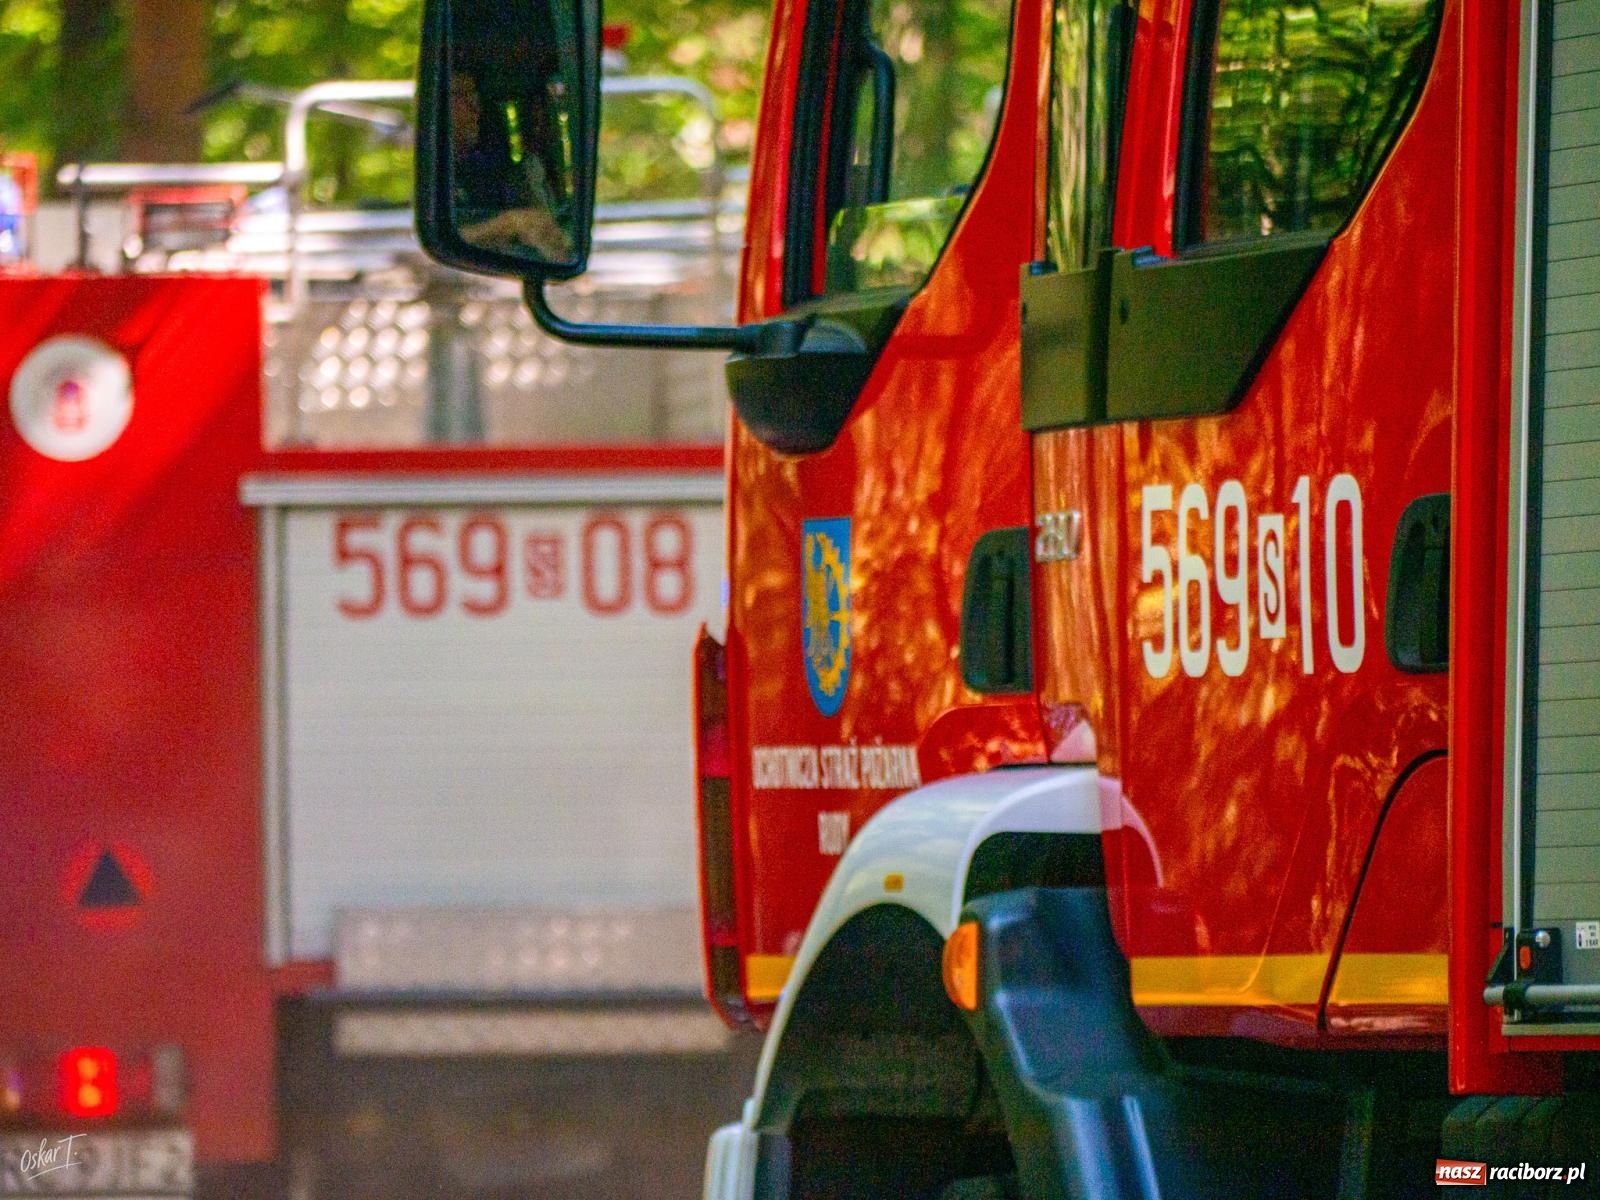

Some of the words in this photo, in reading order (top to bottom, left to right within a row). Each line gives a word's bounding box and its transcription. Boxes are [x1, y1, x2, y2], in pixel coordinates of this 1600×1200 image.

[334, 510, 510, 619] 569
[580, 510, 695, 617] 08
[1142, 480, 1250, 678] 569
[1291, 473, 1365, 674] 10
